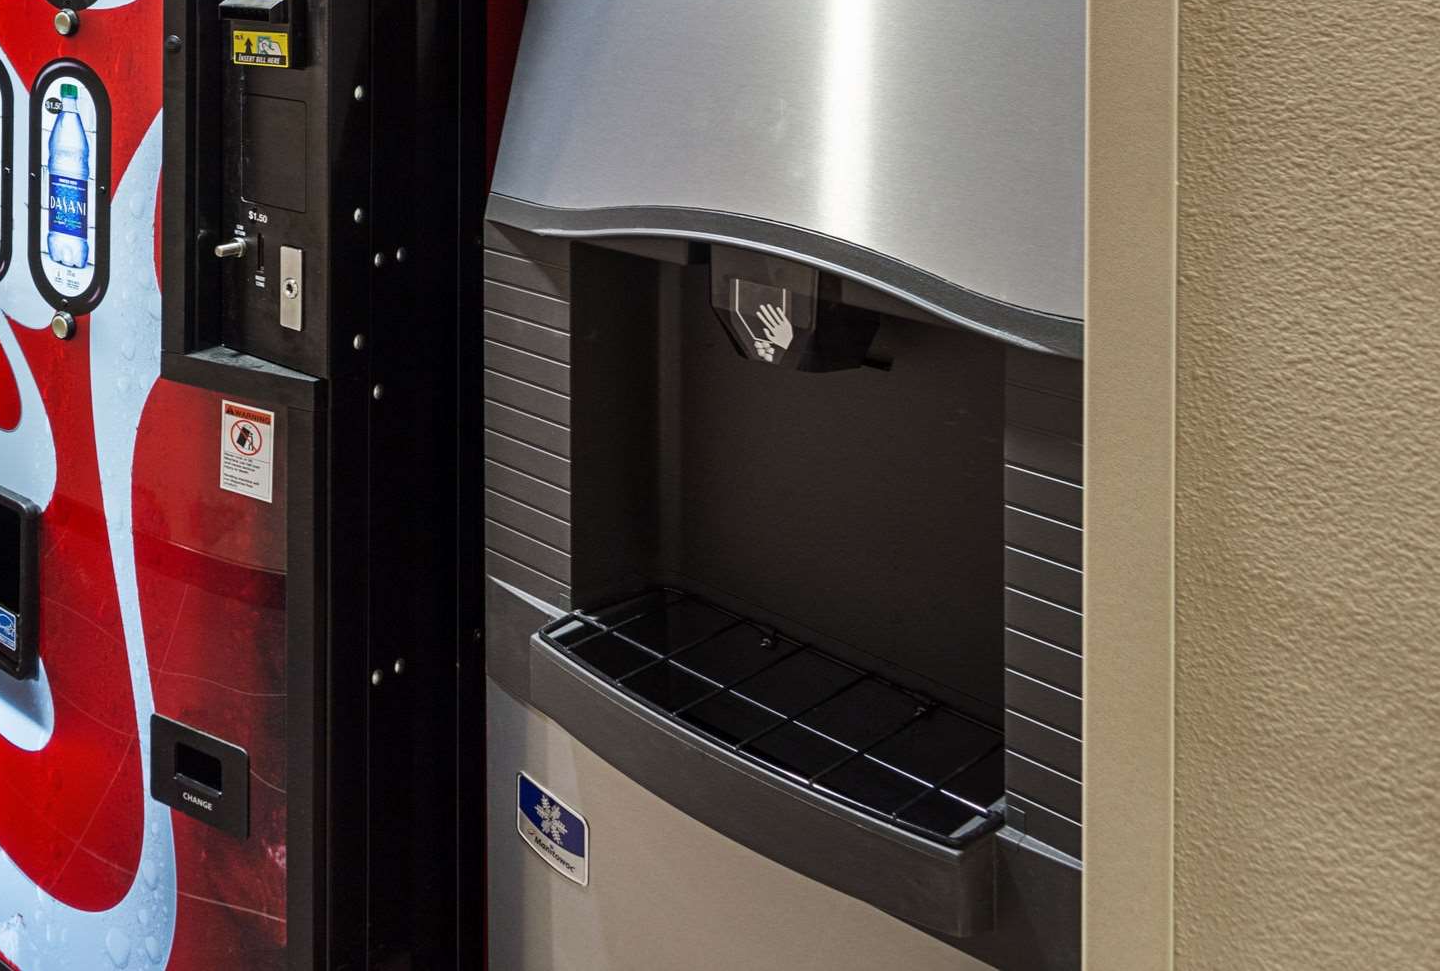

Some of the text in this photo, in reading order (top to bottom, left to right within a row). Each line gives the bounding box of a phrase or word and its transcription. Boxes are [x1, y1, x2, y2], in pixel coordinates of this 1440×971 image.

[50, 195, 87, 216] DASANI
[248, 210, 268, 224] $1.50
[182, 792, 213, 811] CHANGE
[534, 836, 576, 872] Manitowoc
